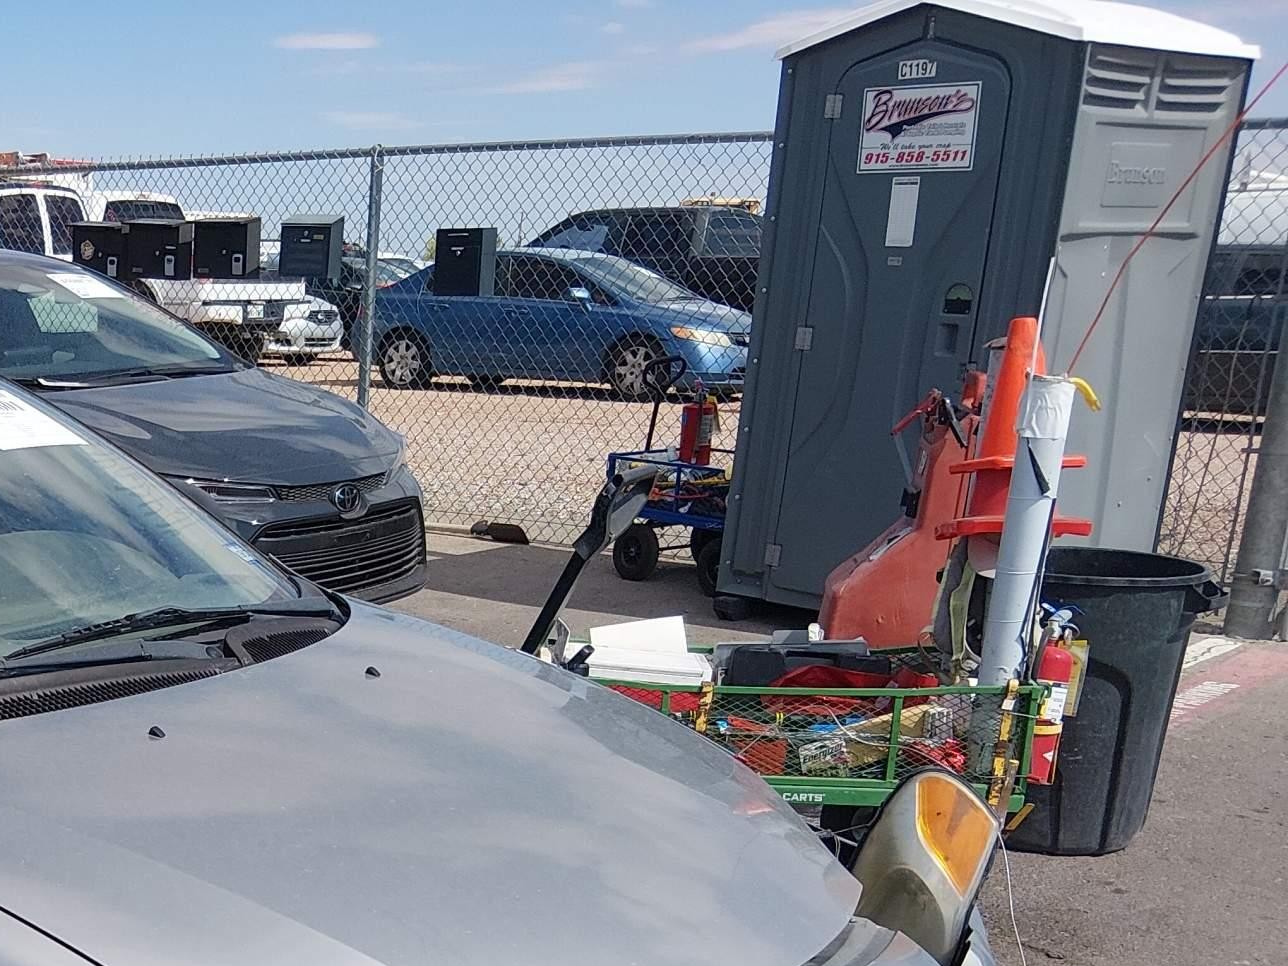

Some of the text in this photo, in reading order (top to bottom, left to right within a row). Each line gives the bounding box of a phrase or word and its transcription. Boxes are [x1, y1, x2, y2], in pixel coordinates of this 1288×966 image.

[865, 88, 975, 132] Brunson's
[863, 149, 969, 165] 915-858-5511
[782, 792, 824, 802] CARTS
